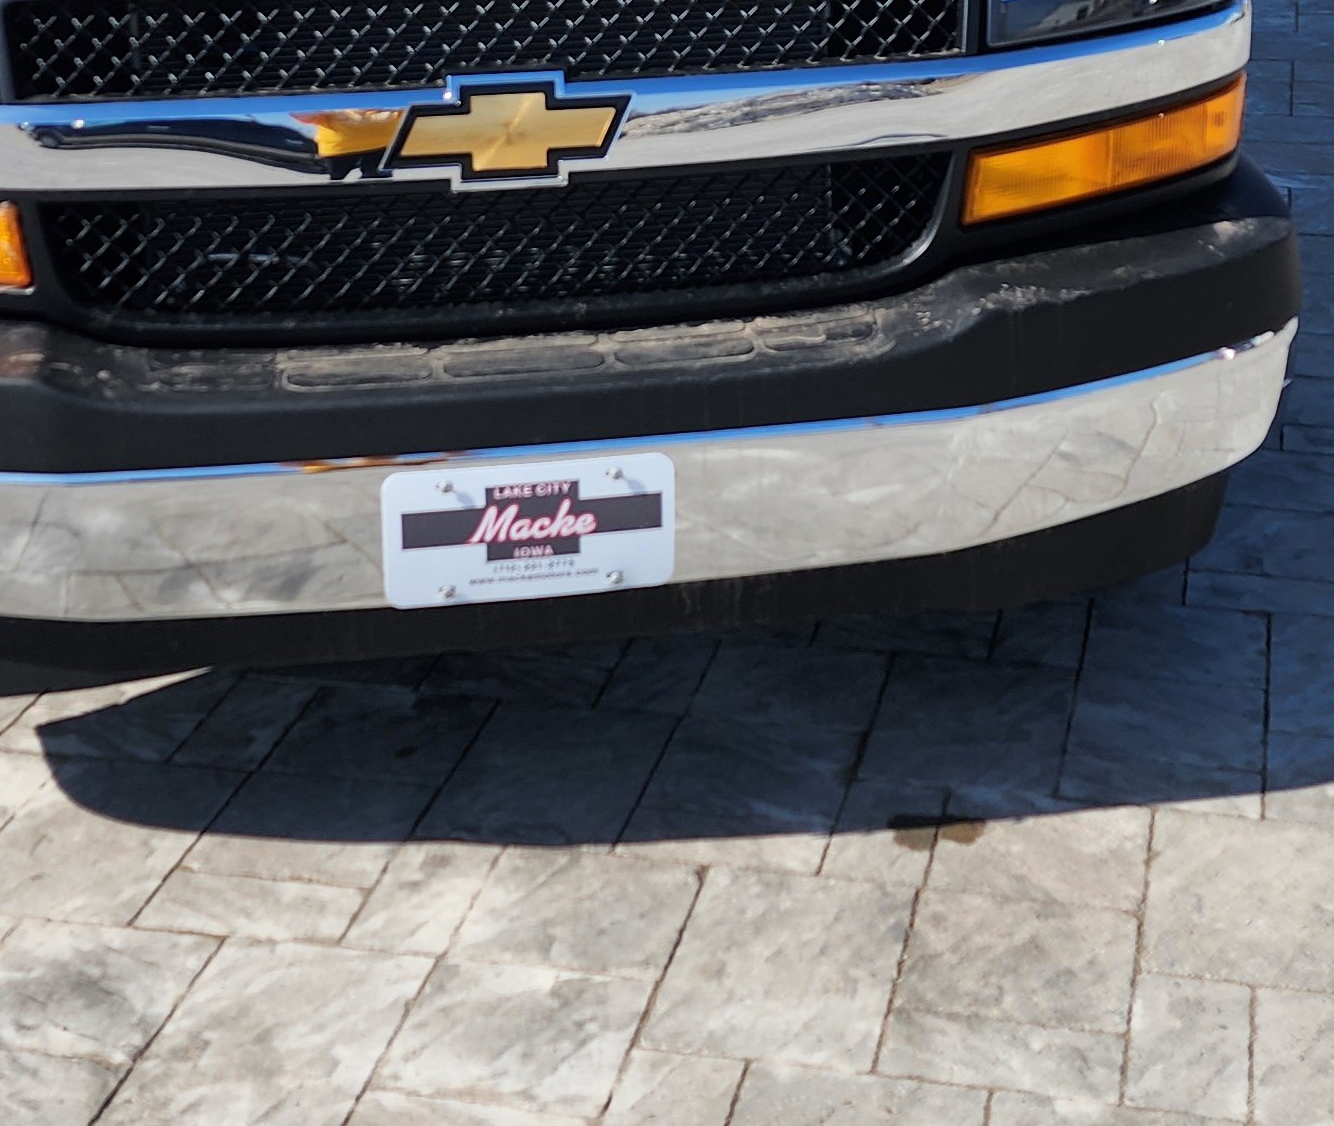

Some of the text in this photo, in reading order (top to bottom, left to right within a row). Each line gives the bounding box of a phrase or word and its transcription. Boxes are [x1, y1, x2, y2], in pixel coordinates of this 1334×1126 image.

[492, 481, 572, 500] LAKE CITY
[467, 498, 599, 545] Macke
[513, 544, 555, 559] IOWA
